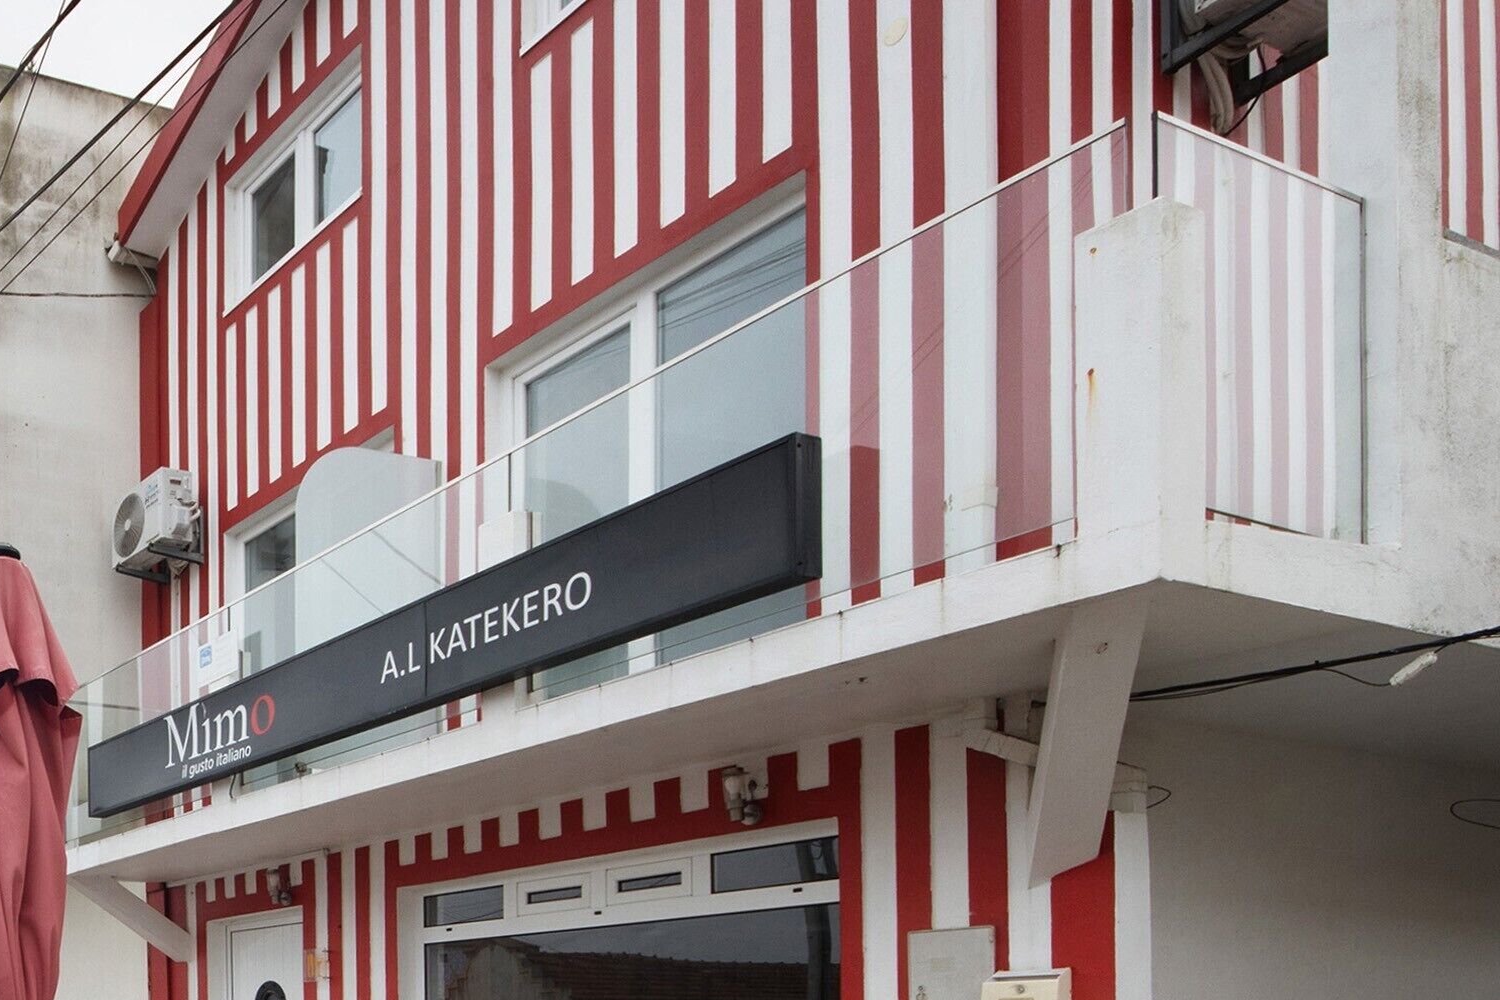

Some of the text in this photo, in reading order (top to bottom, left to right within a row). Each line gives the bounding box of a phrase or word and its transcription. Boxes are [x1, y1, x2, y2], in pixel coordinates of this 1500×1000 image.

[380, 571, 592, 684] A.L KATEKERO
[181, 745, 252, 779] il gusto italiano
